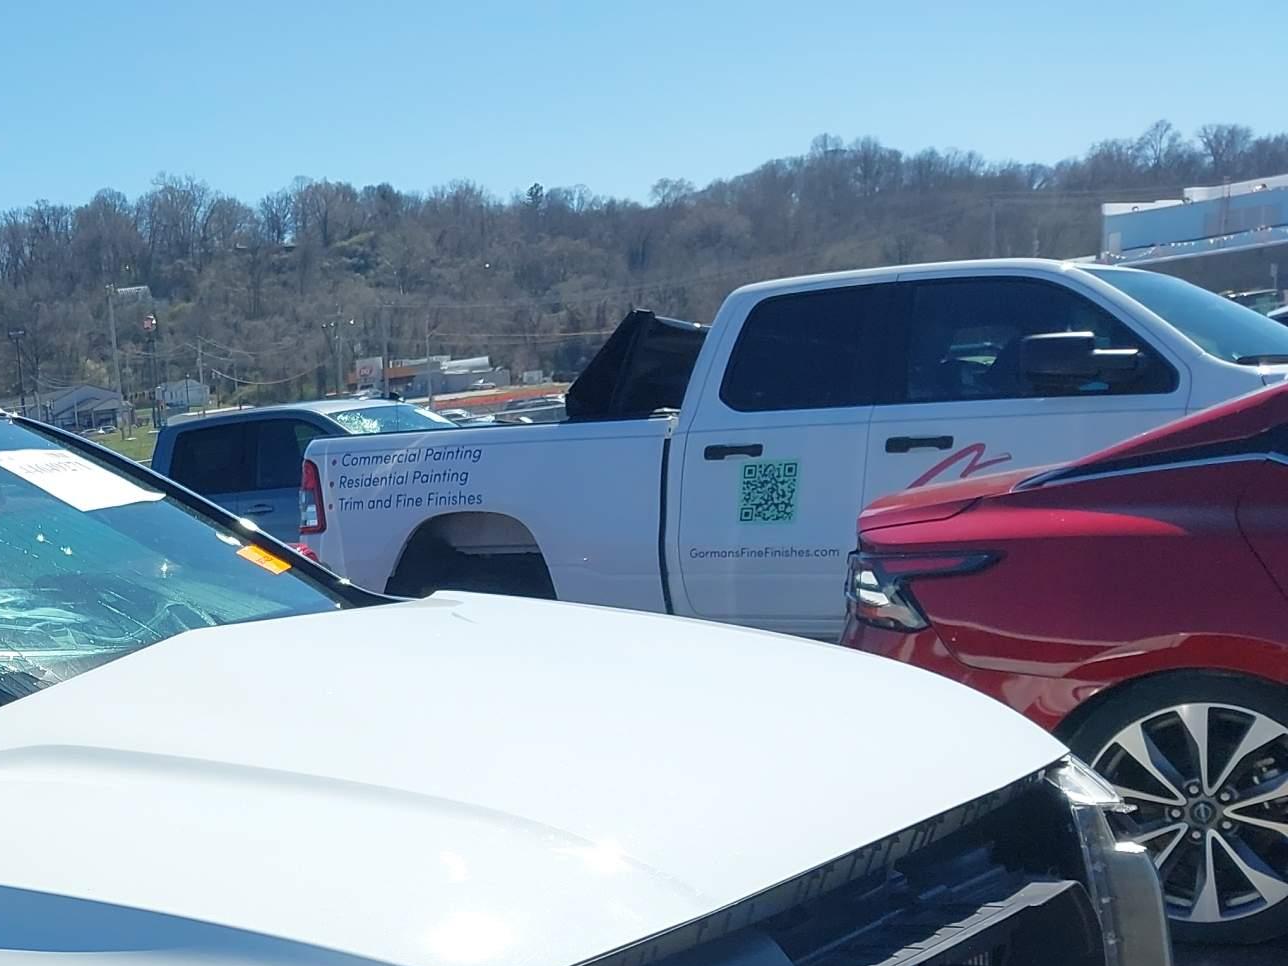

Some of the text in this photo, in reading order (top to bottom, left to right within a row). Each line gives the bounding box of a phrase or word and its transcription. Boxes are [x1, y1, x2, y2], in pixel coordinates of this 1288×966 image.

[341, 446, 482, 467] Commercial Painting
[339, 468, 469, 489] Residential Painting
[338, 490, 483, 512] Trim and Fine Finishes
[689, 546, 840, 559] GormansFineFinishes.com
